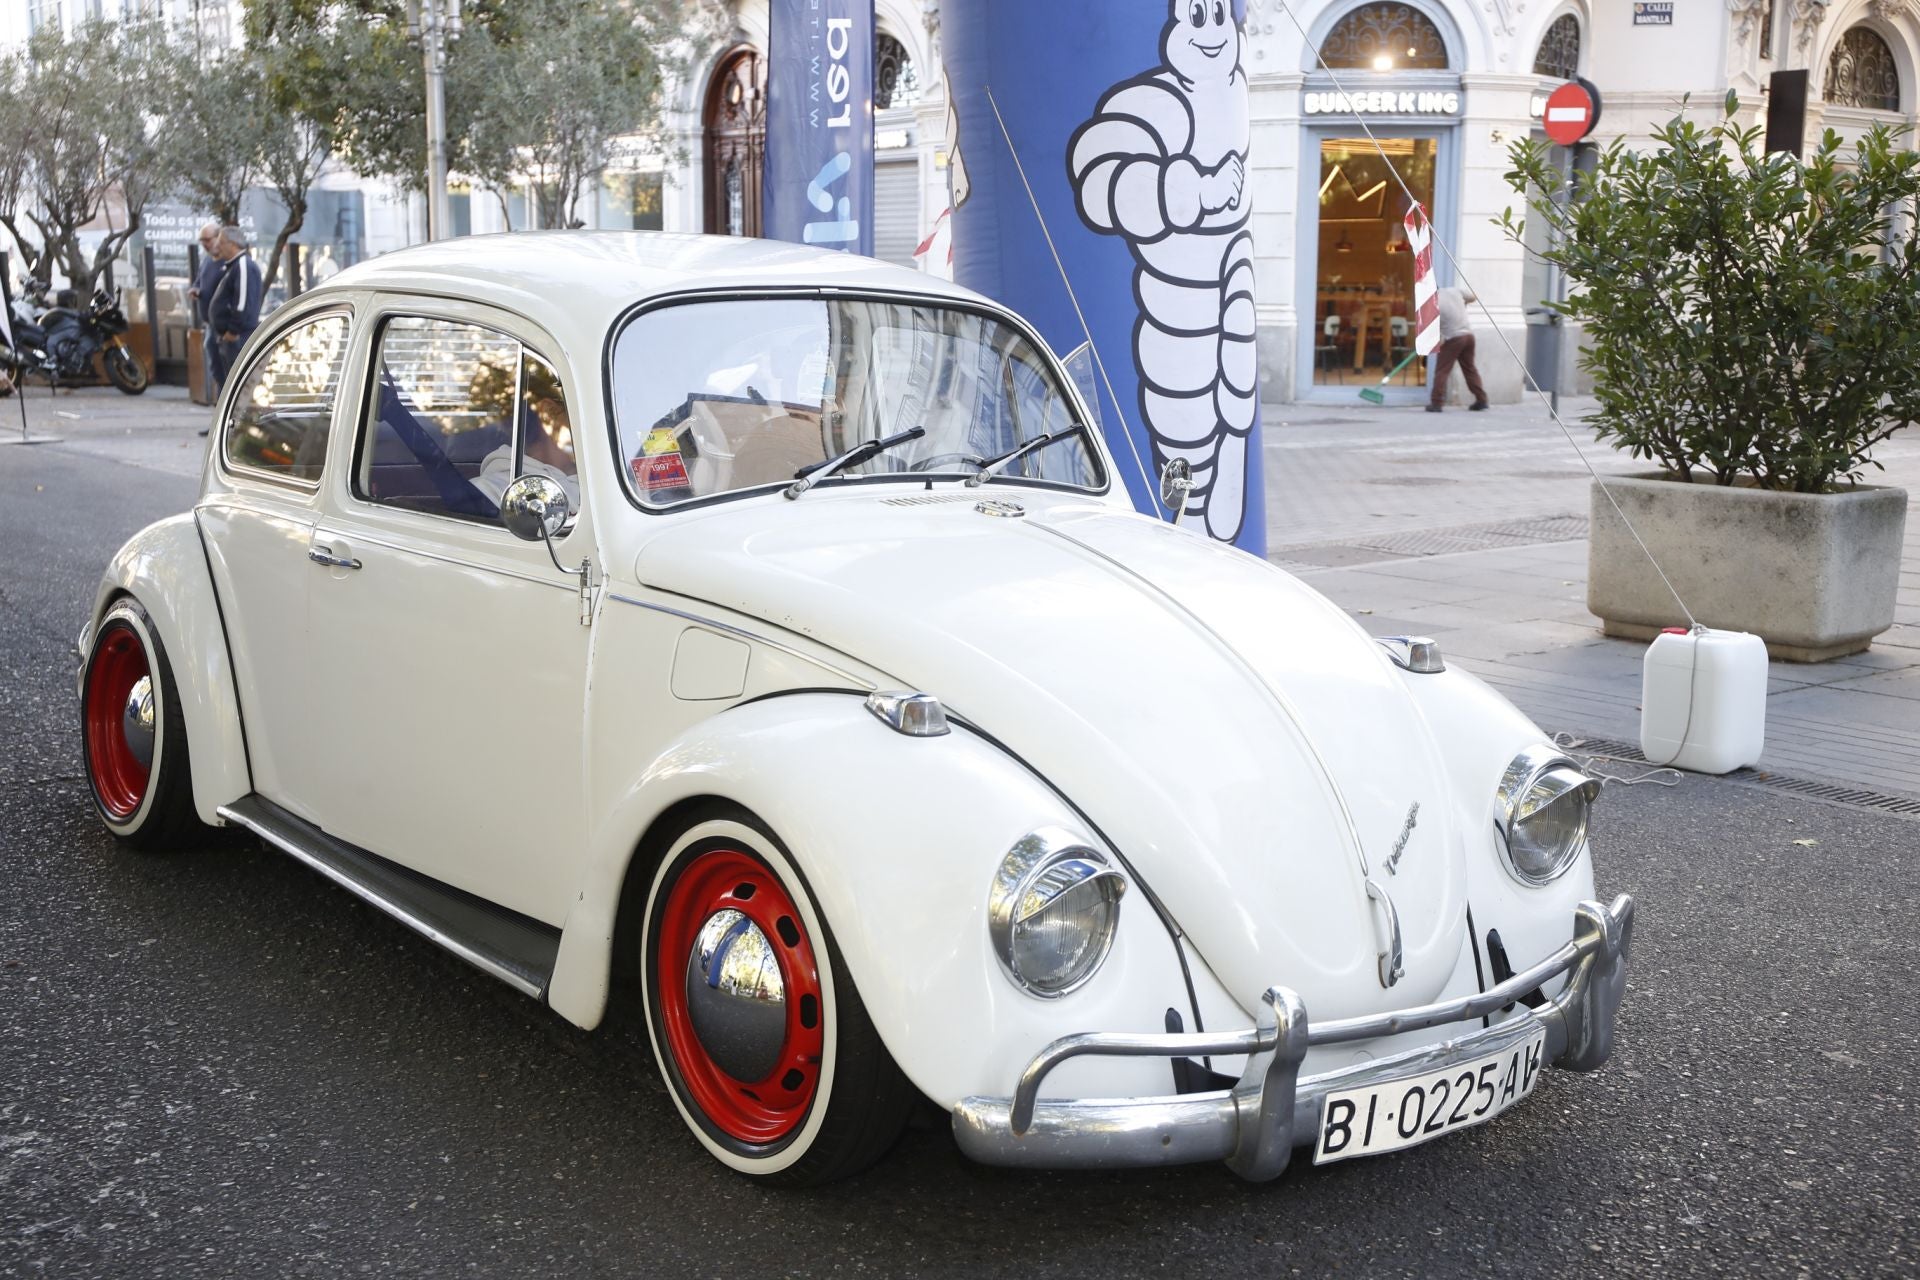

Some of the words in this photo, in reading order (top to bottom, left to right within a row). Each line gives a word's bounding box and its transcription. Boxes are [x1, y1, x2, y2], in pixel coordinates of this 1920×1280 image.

[1647, 3, 1671, 12] CALLE
[1636, 14, 1671, 24] MANTILLA
[1304, 92, 1398, 113] BURGER
[1399, 92, 1459, 113] KING
[143, 213, 176, 226] Todo
[178, 217, 193, 226] es
[144, 228, 193, 241] cuando
[651, 463, 670, 472] 1997
